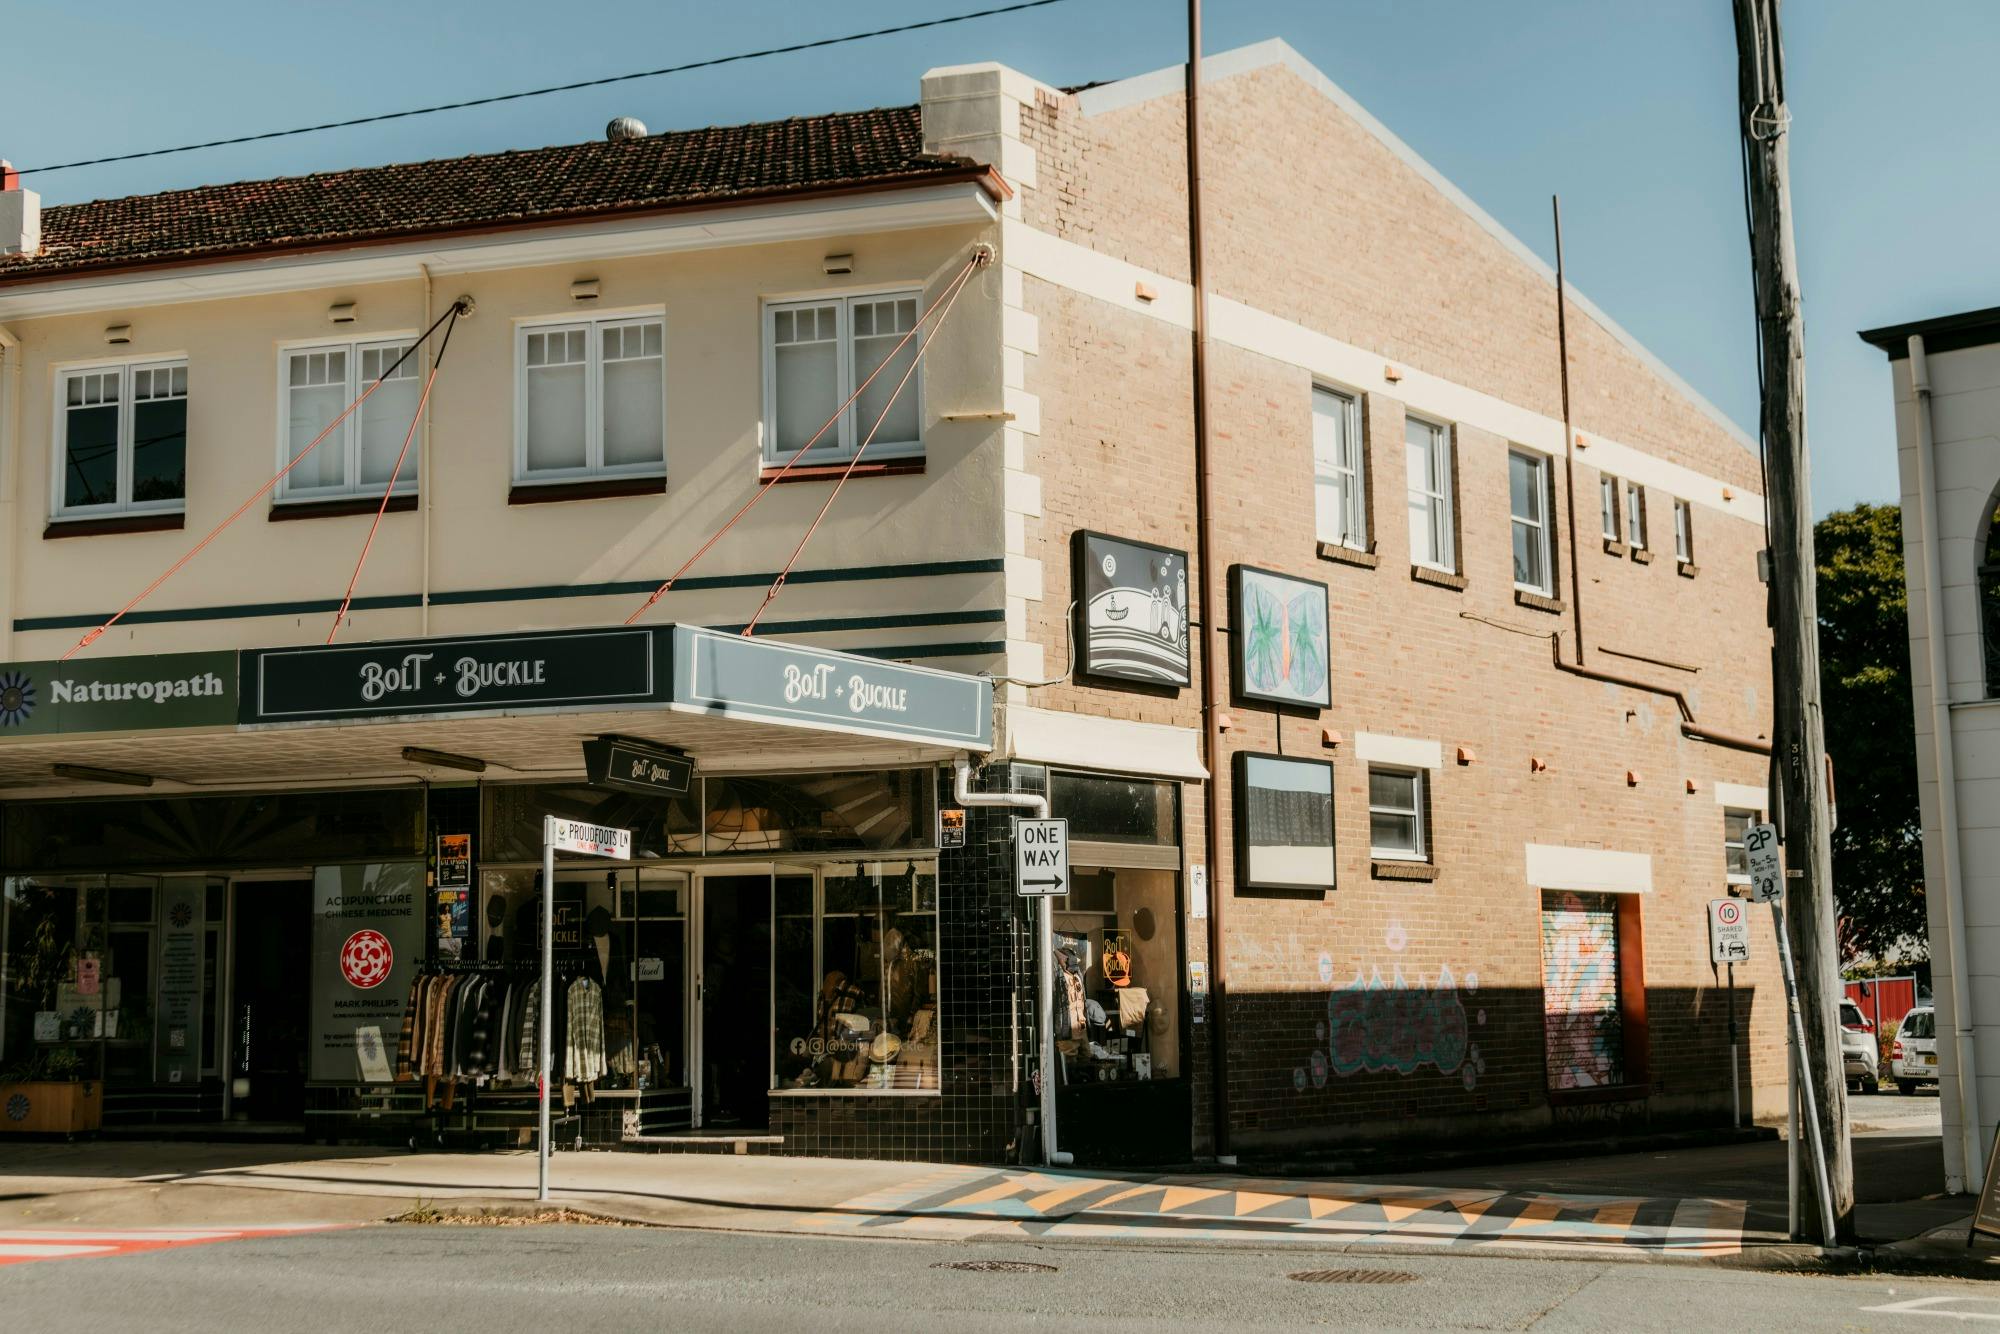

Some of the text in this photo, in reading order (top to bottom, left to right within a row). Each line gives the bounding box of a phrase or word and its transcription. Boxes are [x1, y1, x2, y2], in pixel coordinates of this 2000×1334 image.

[454, 656, 546, 697] BUCKLE
[50, 671, 224, 704] Naturopath
[848, 674, 907, 713] BUCKLE
[569, 823, 618, 846] PROUDFOOTS
[1024, 827, 1059, 844] ONE
[1746, 830, 1772, 852] 2P
[1024, 849, 1060, 867] WAY
[325, 894, 413, 906] ACUPUNCTURE
[324, 908, 413, 919] CHINESE MEDICINE
[1723, 908, 1735, 919] 10
[1717, 925, 1743, 933] SHARED
[1721, 933, 1738, 941] ZONE
[334, 999, 399, 1009] MARK PHILLIPS
